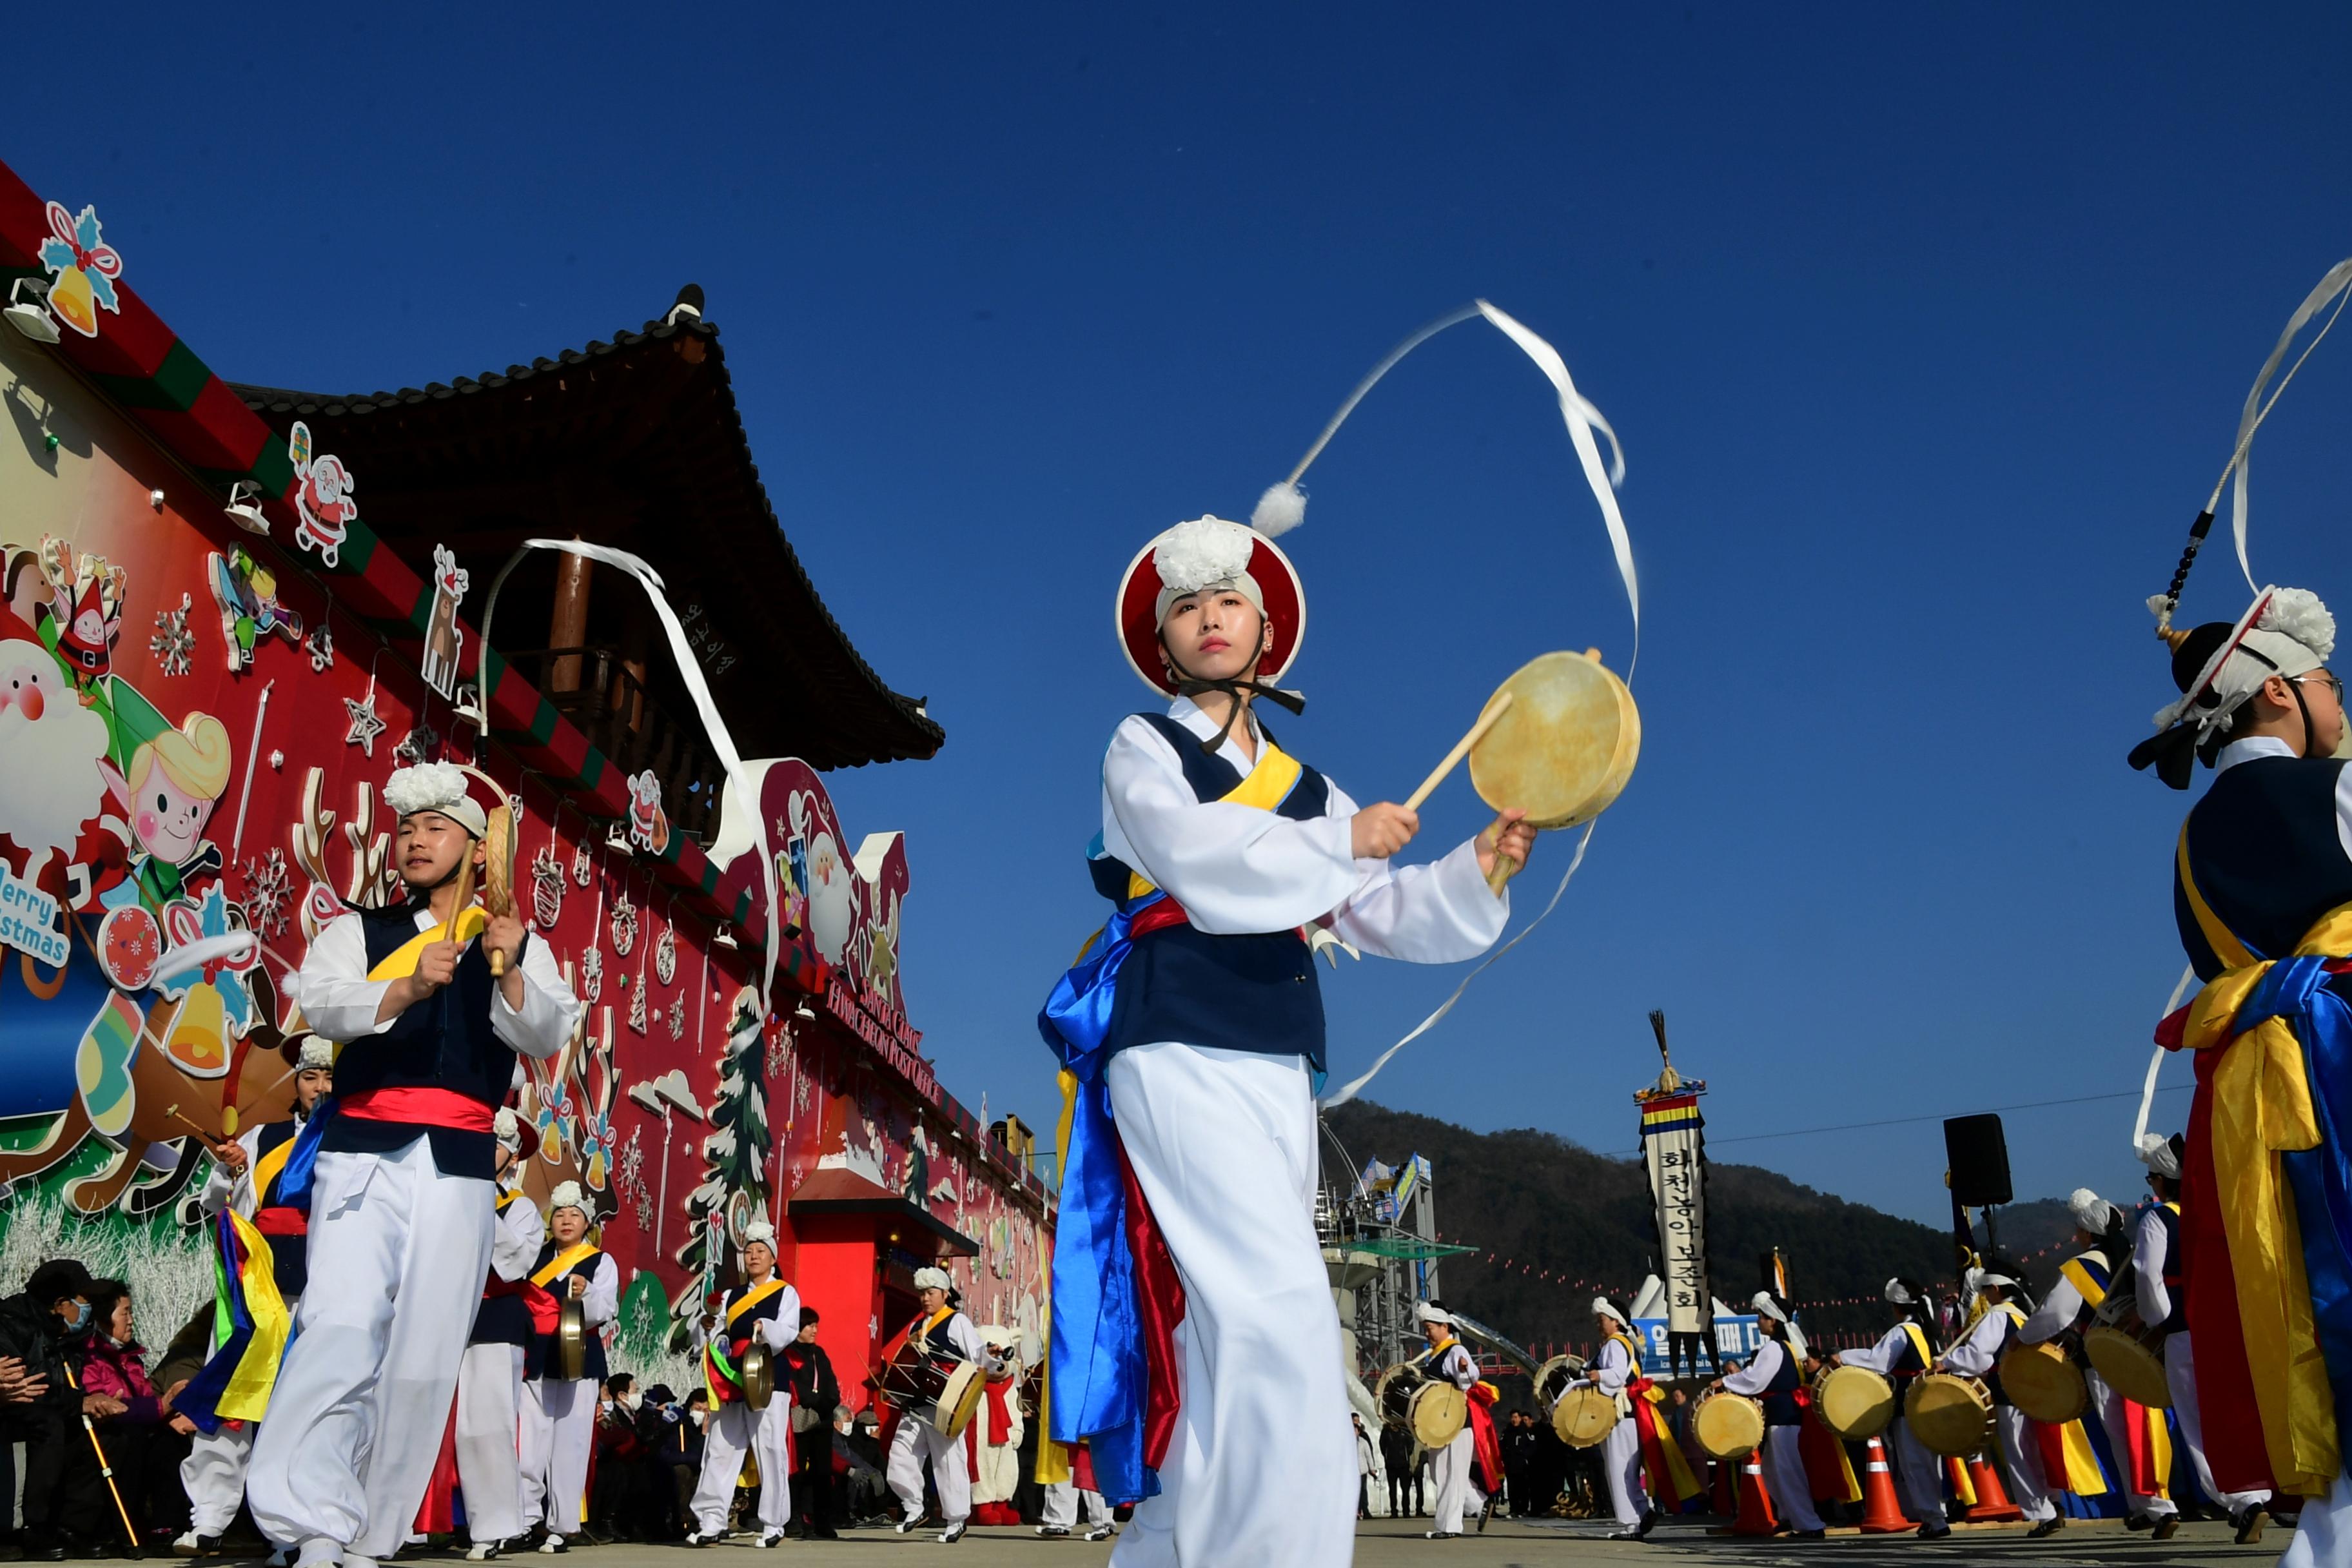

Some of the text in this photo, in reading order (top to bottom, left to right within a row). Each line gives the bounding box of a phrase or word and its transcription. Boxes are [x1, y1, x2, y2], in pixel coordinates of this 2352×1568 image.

[0, 867, 52, 926] erry
[0, 913, 64, 961] stmas
[827, 977, 940, 1106] HWACHEON POST OFFICE
[860, 976, 923, 1056] SANTA CLAUS
[1661, 1149, 1703, 1311] 화천농악보존회
